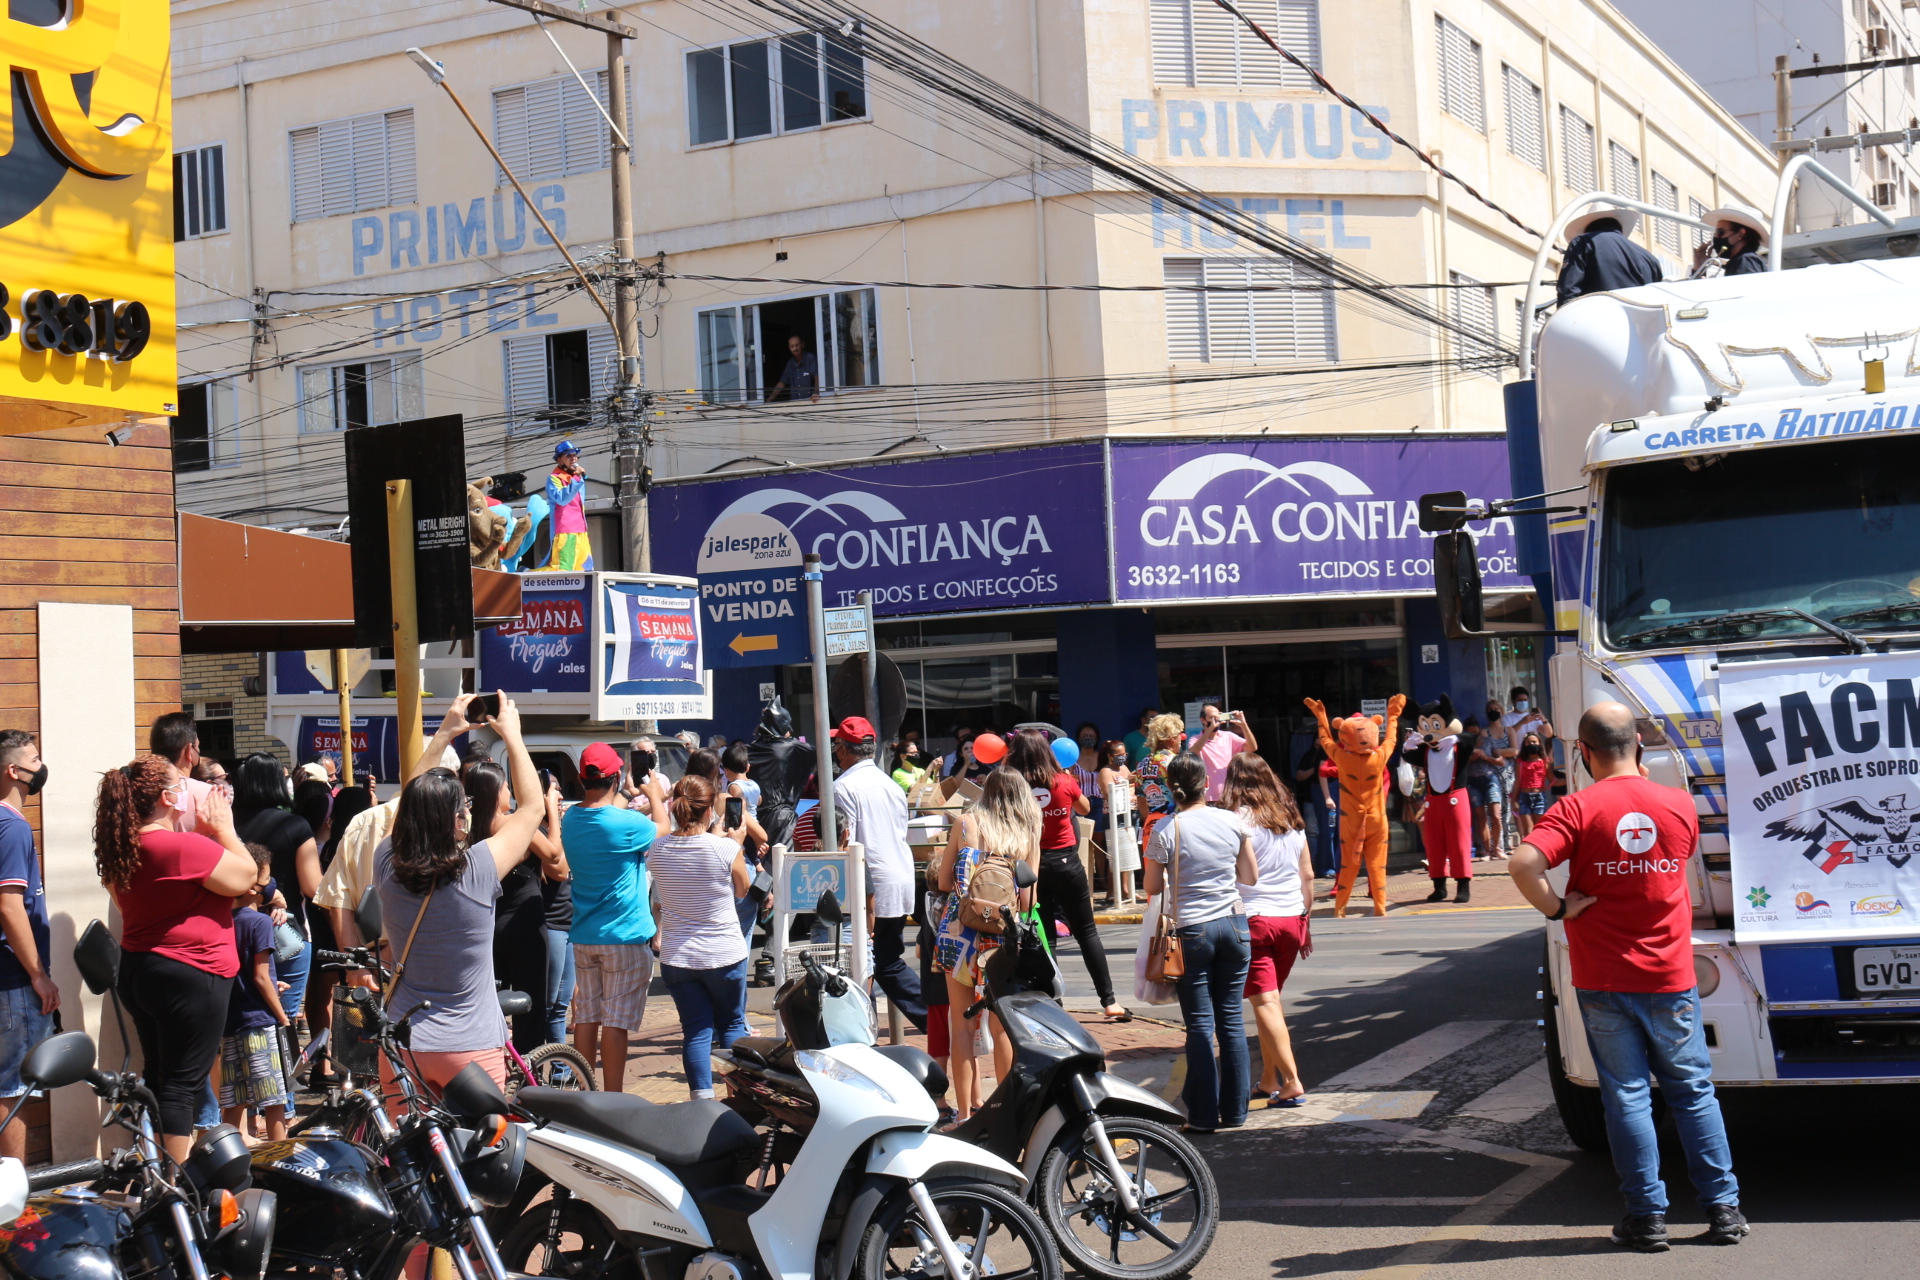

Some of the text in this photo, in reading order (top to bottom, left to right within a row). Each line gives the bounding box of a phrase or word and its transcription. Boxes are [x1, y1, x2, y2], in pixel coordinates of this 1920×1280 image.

[1122, 98, 1393, 160] PRIMUS
[352, 184, 568, 276] PRIMUS
[1151, 197, 1372, 249] HOTEL
[373, 281, 559, 349] HOTEL
[1644, 422, 1766, 450] CARRETA
[1773, 401, 1908, 440] BATIDÃO
[417, 515, 465, 531] METAL MERIGHI
[1140, 505, 1261, 547] CASA
[706, 532, 788, 558] jalespark
[754, 548, 791, 559] zona azul
[811, 515, 1053, 572] CONFIANÇA
[1128, 563, 1240, 586] 3632-1163
[1299, 560, 1380, 579] TECIDOS
[1386, 560, 1397, 576] E
[524, 577, 580, 586] de setembro
[702, 577, 797, 599] PONTO DE
[918, 584, 928, 600] E
[933, 567, 1058, 598] CONFECÇÕES
[708, 599, 795, 622] VENDA
[640, 620, 694, 636] SEMANA
[505, 630, 572, 673] Freguês
[558, 663, 585, 673] Jales
[681, 661, 694, 670] Jales
[1752, 767, 1841, 812] ORQUESTRA
[1843, 763, 1863, 781] DE
[1593, 858, 1679, 876] TECHNOS
[1789, 883, 1811, 891] Apoio
[1844, 881, 1879, 889] Patrocínio
[1850, 898, 1904, 912] PROENÇA
[271, 1160, 322, 1181] HONDA
[652, 1221, 688, 1235] HONDA
